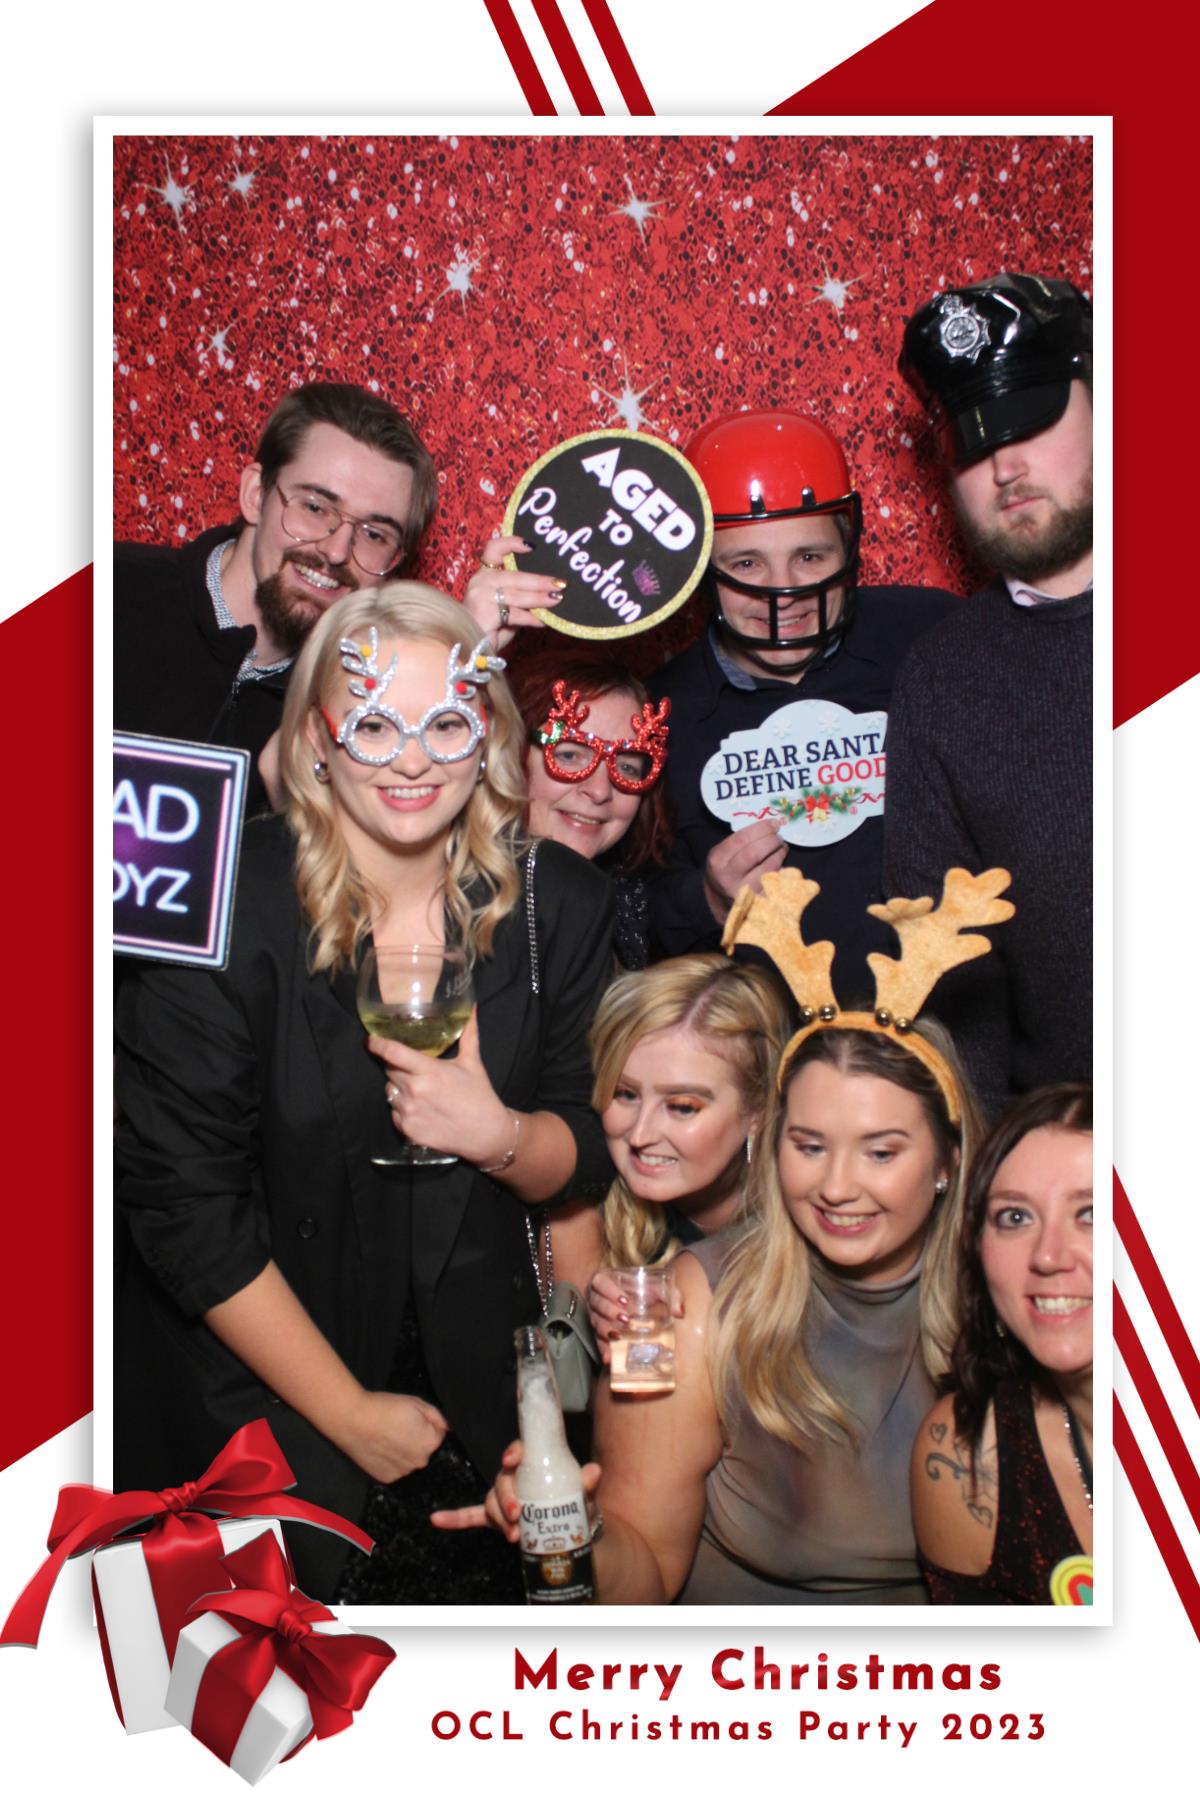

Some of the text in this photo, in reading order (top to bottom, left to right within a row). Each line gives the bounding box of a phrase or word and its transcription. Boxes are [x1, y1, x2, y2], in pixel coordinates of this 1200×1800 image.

[581, 447, 696, 551] AGED
[598, 508, 634, 546] TO
[518, 487, 642, 624] Perfection
[723, 732, 887, 775] DEAR SANT
[715, 768, 812, 801] DEFINE
[520, 1502, 580, 1524] Corona
[537, 1521, 570, 1535] Extra
